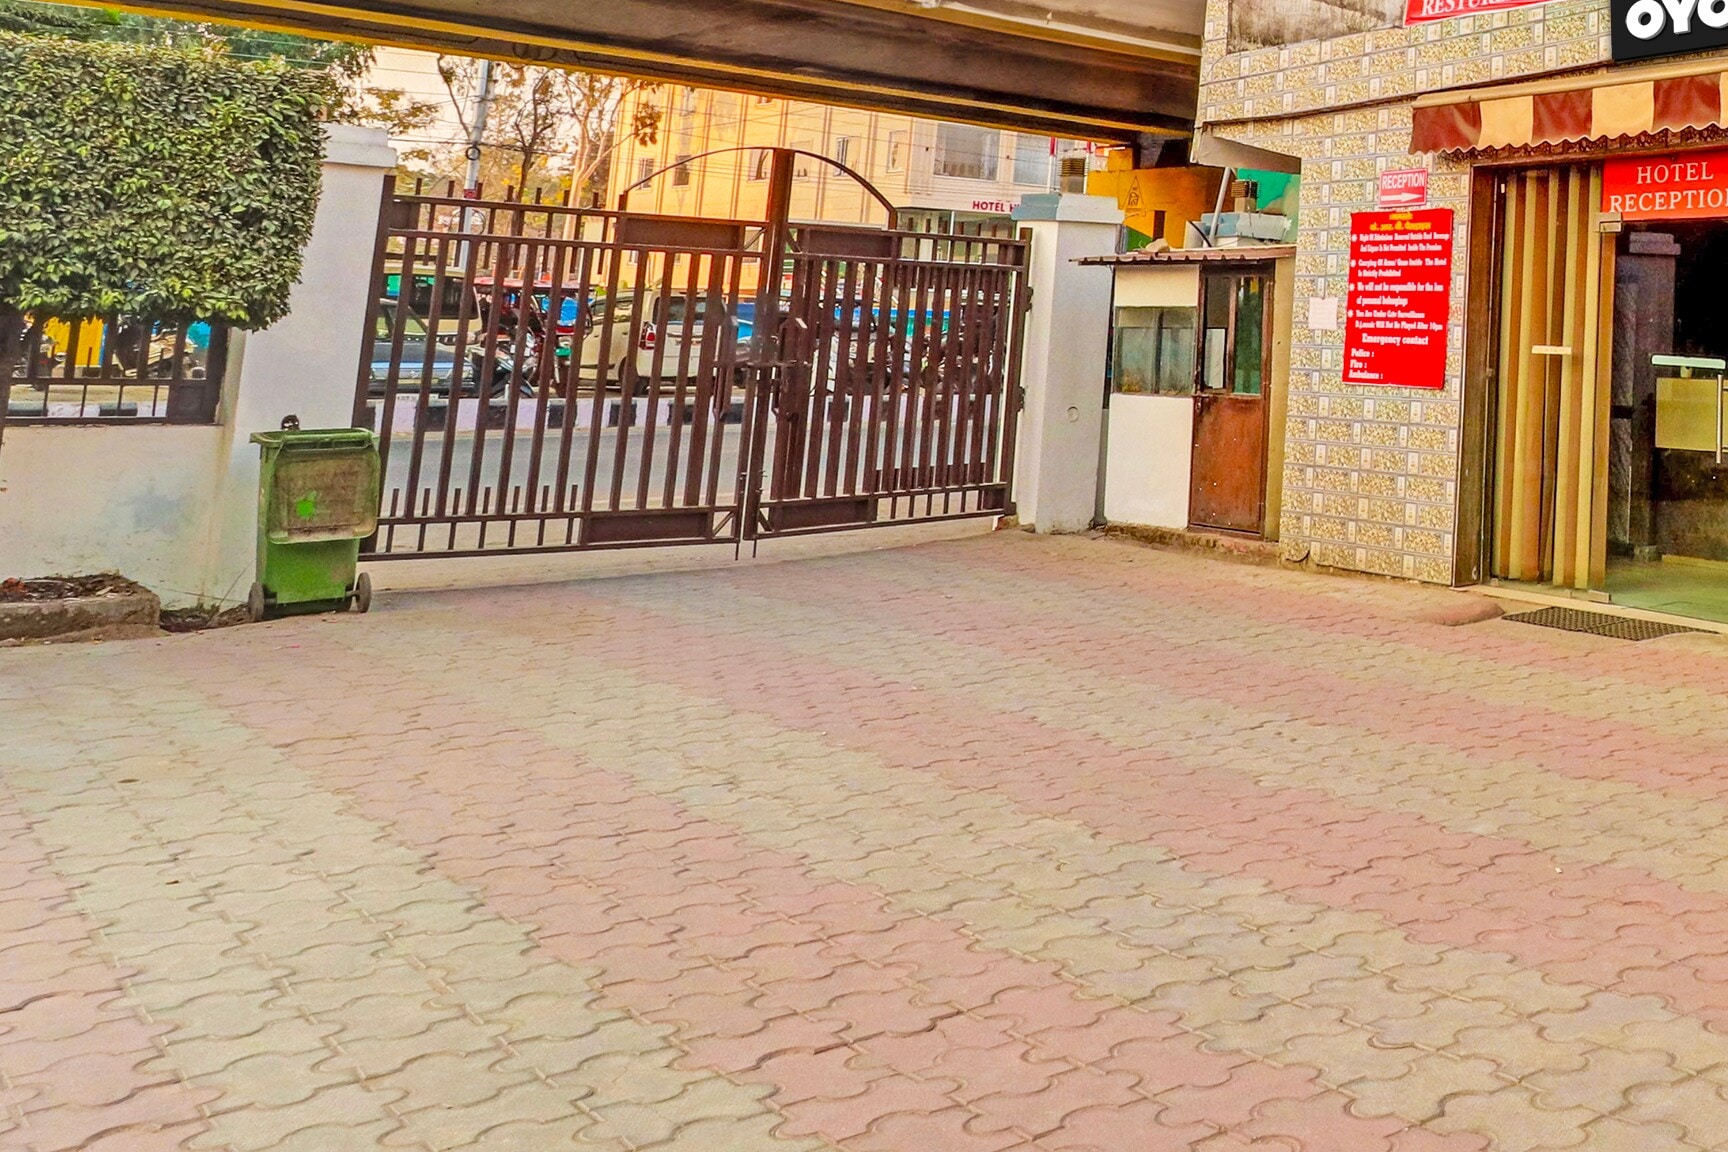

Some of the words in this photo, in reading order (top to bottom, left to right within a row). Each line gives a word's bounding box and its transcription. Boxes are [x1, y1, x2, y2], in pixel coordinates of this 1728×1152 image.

[1636, 162, 1714, 185] HOTEL
[1382, 173, 1424, 189] RECEPTION
[972, 201, 1005, 212] HOTEL
[1362, 333, 1401, 346] Emergency
[1402, 336, 1428, 345] contact
[1351, 348, 1370, 357] Police
[1350, 359, 1363, 368] Fire
[1349, 370, 1379, 379] Ambulance
